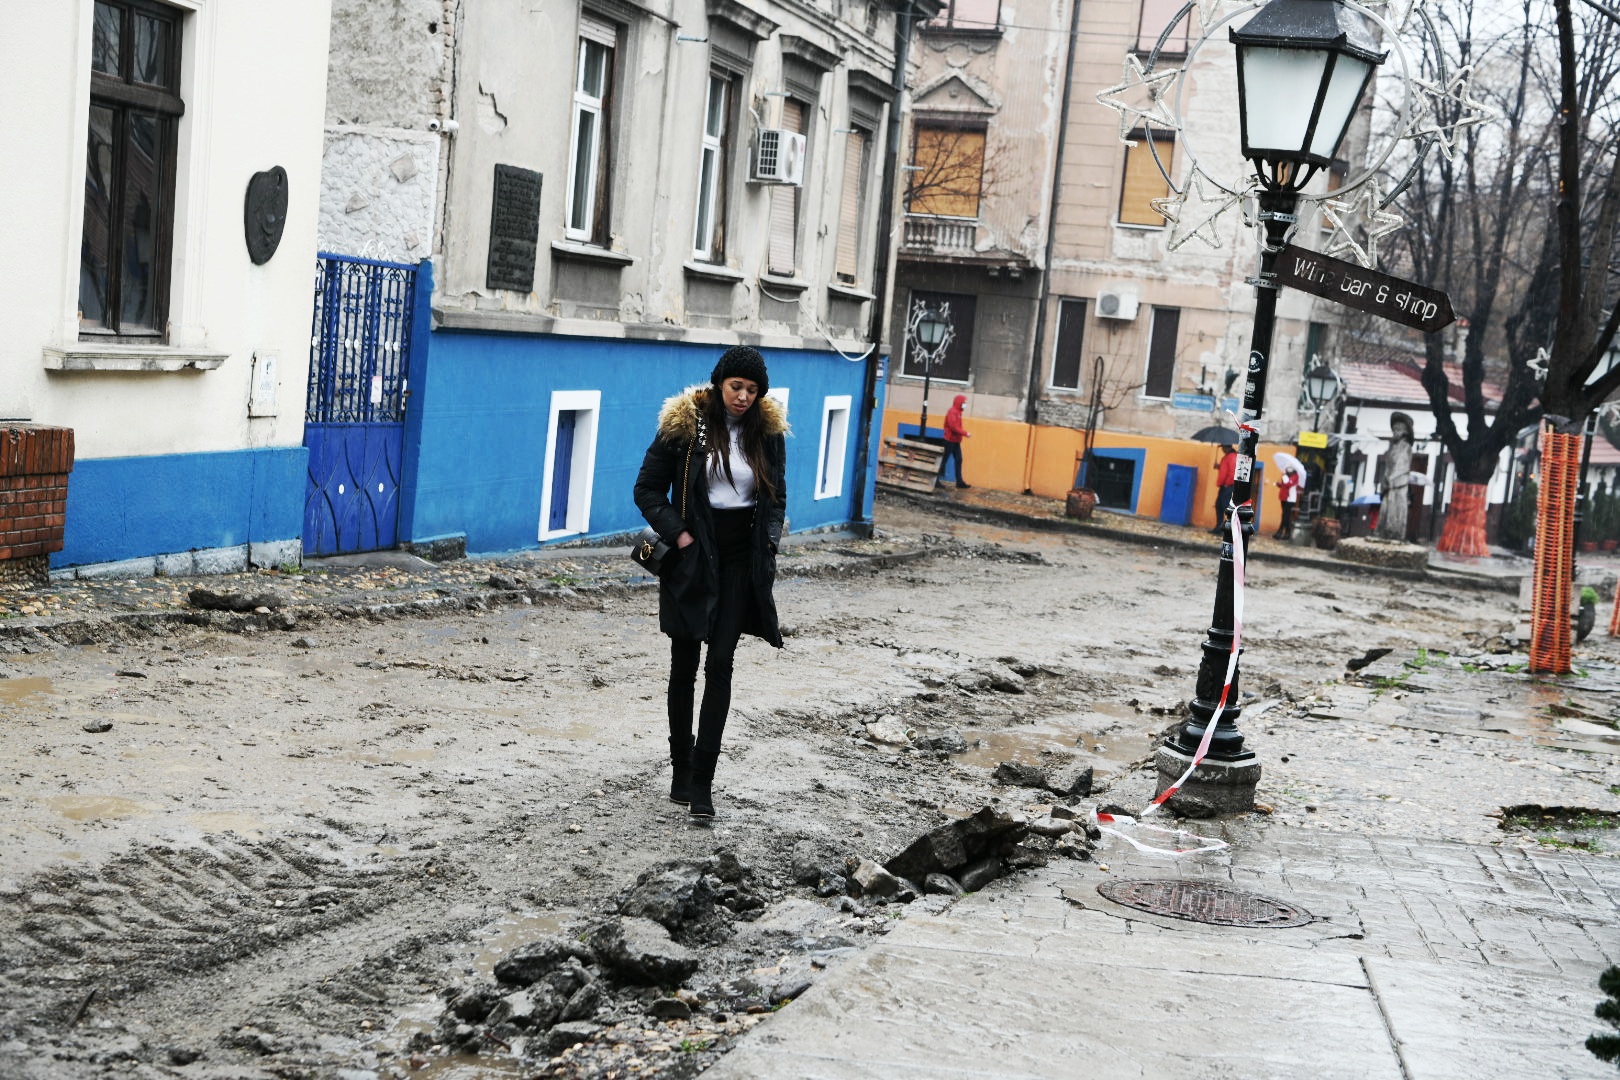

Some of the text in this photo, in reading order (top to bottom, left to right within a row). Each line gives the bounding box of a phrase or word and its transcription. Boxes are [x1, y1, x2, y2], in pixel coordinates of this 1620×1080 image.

[1340, 272, 1371, 297] bar
[1375, 285, 1389, 303] &
[1395, 292, 1438, 321] shop
